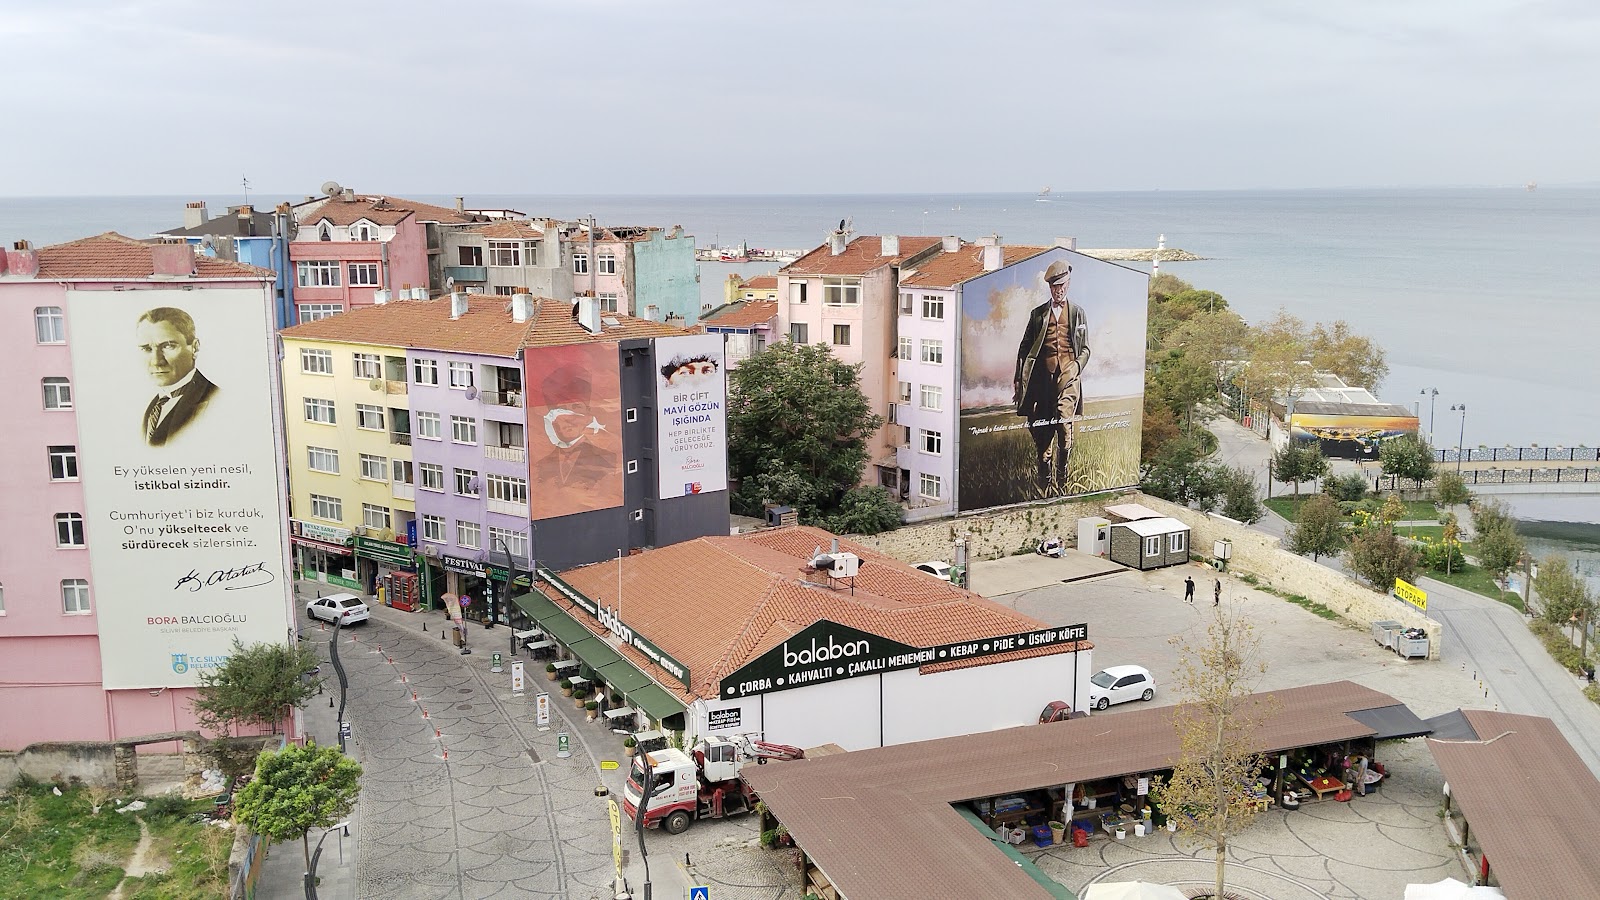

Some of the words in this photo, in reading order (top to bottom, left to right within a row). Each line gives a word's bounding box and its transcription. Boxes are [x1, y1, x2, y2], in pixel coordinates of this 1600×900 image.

[673, 393, 688, 403] BİR
[689, 391, 710, 403] ÇİFT
[663, 404, 687, 416] MAVİ
[688, 402, 720, 413] GÖZÜN
[672, 414, 712, 427] IŞIĞINDA
[668, 429, 683, 438] HEP
[684, 426, 716, 436] BİRLİKTE
[673, 433, 711, 445] GELECEĞE
[114, 466, 129, 478] Ey
[132, 465, 187, 478] yükselen
[190, 464, 216, 476] yeni
[220, 463, 252, 476] nesil,
[134, 480, 181, 490] istikbal
[183, 479, 231, 490] sizindir.
[109, 509, 192, 523] Cumhuriyet'i
[196, 509, 214, 519] biz
[217, 508, 264, 519] kurduk,
[123, 525, 154, 535] O'nu
[158, 524, 232, 536] yükseltecek
[235, 525, 249, 533] ve
[121, 539, 189, 550] sürdürecek
[192, 538, 257, 548] sizlersiniz.
[444, 556, 486, 572] FESTİVAL
[1396, 586, 1426, 609] OTOPARK
[147, 616, 179, 625] BORA
[181, 612, 247, 625] BALCIOĞLU
[597, 598, 633, 645] balaban
[783, 634, 870, 668] balaban
[739, 677, 772, 697] ÇORBA
[788, 666, 833, 685] KAHVALTI
[848, 655, 886, 676] ÇAKALLI
[888, 647, 936, 669] MENEMENİ
[950, 643, 979, 658] KEBAP
[1028, 631, 1057, 646] ÜSKÜP
[1058, 626, 1085, 641] KÖFTE
[711, 711, 739, 721] balaban
